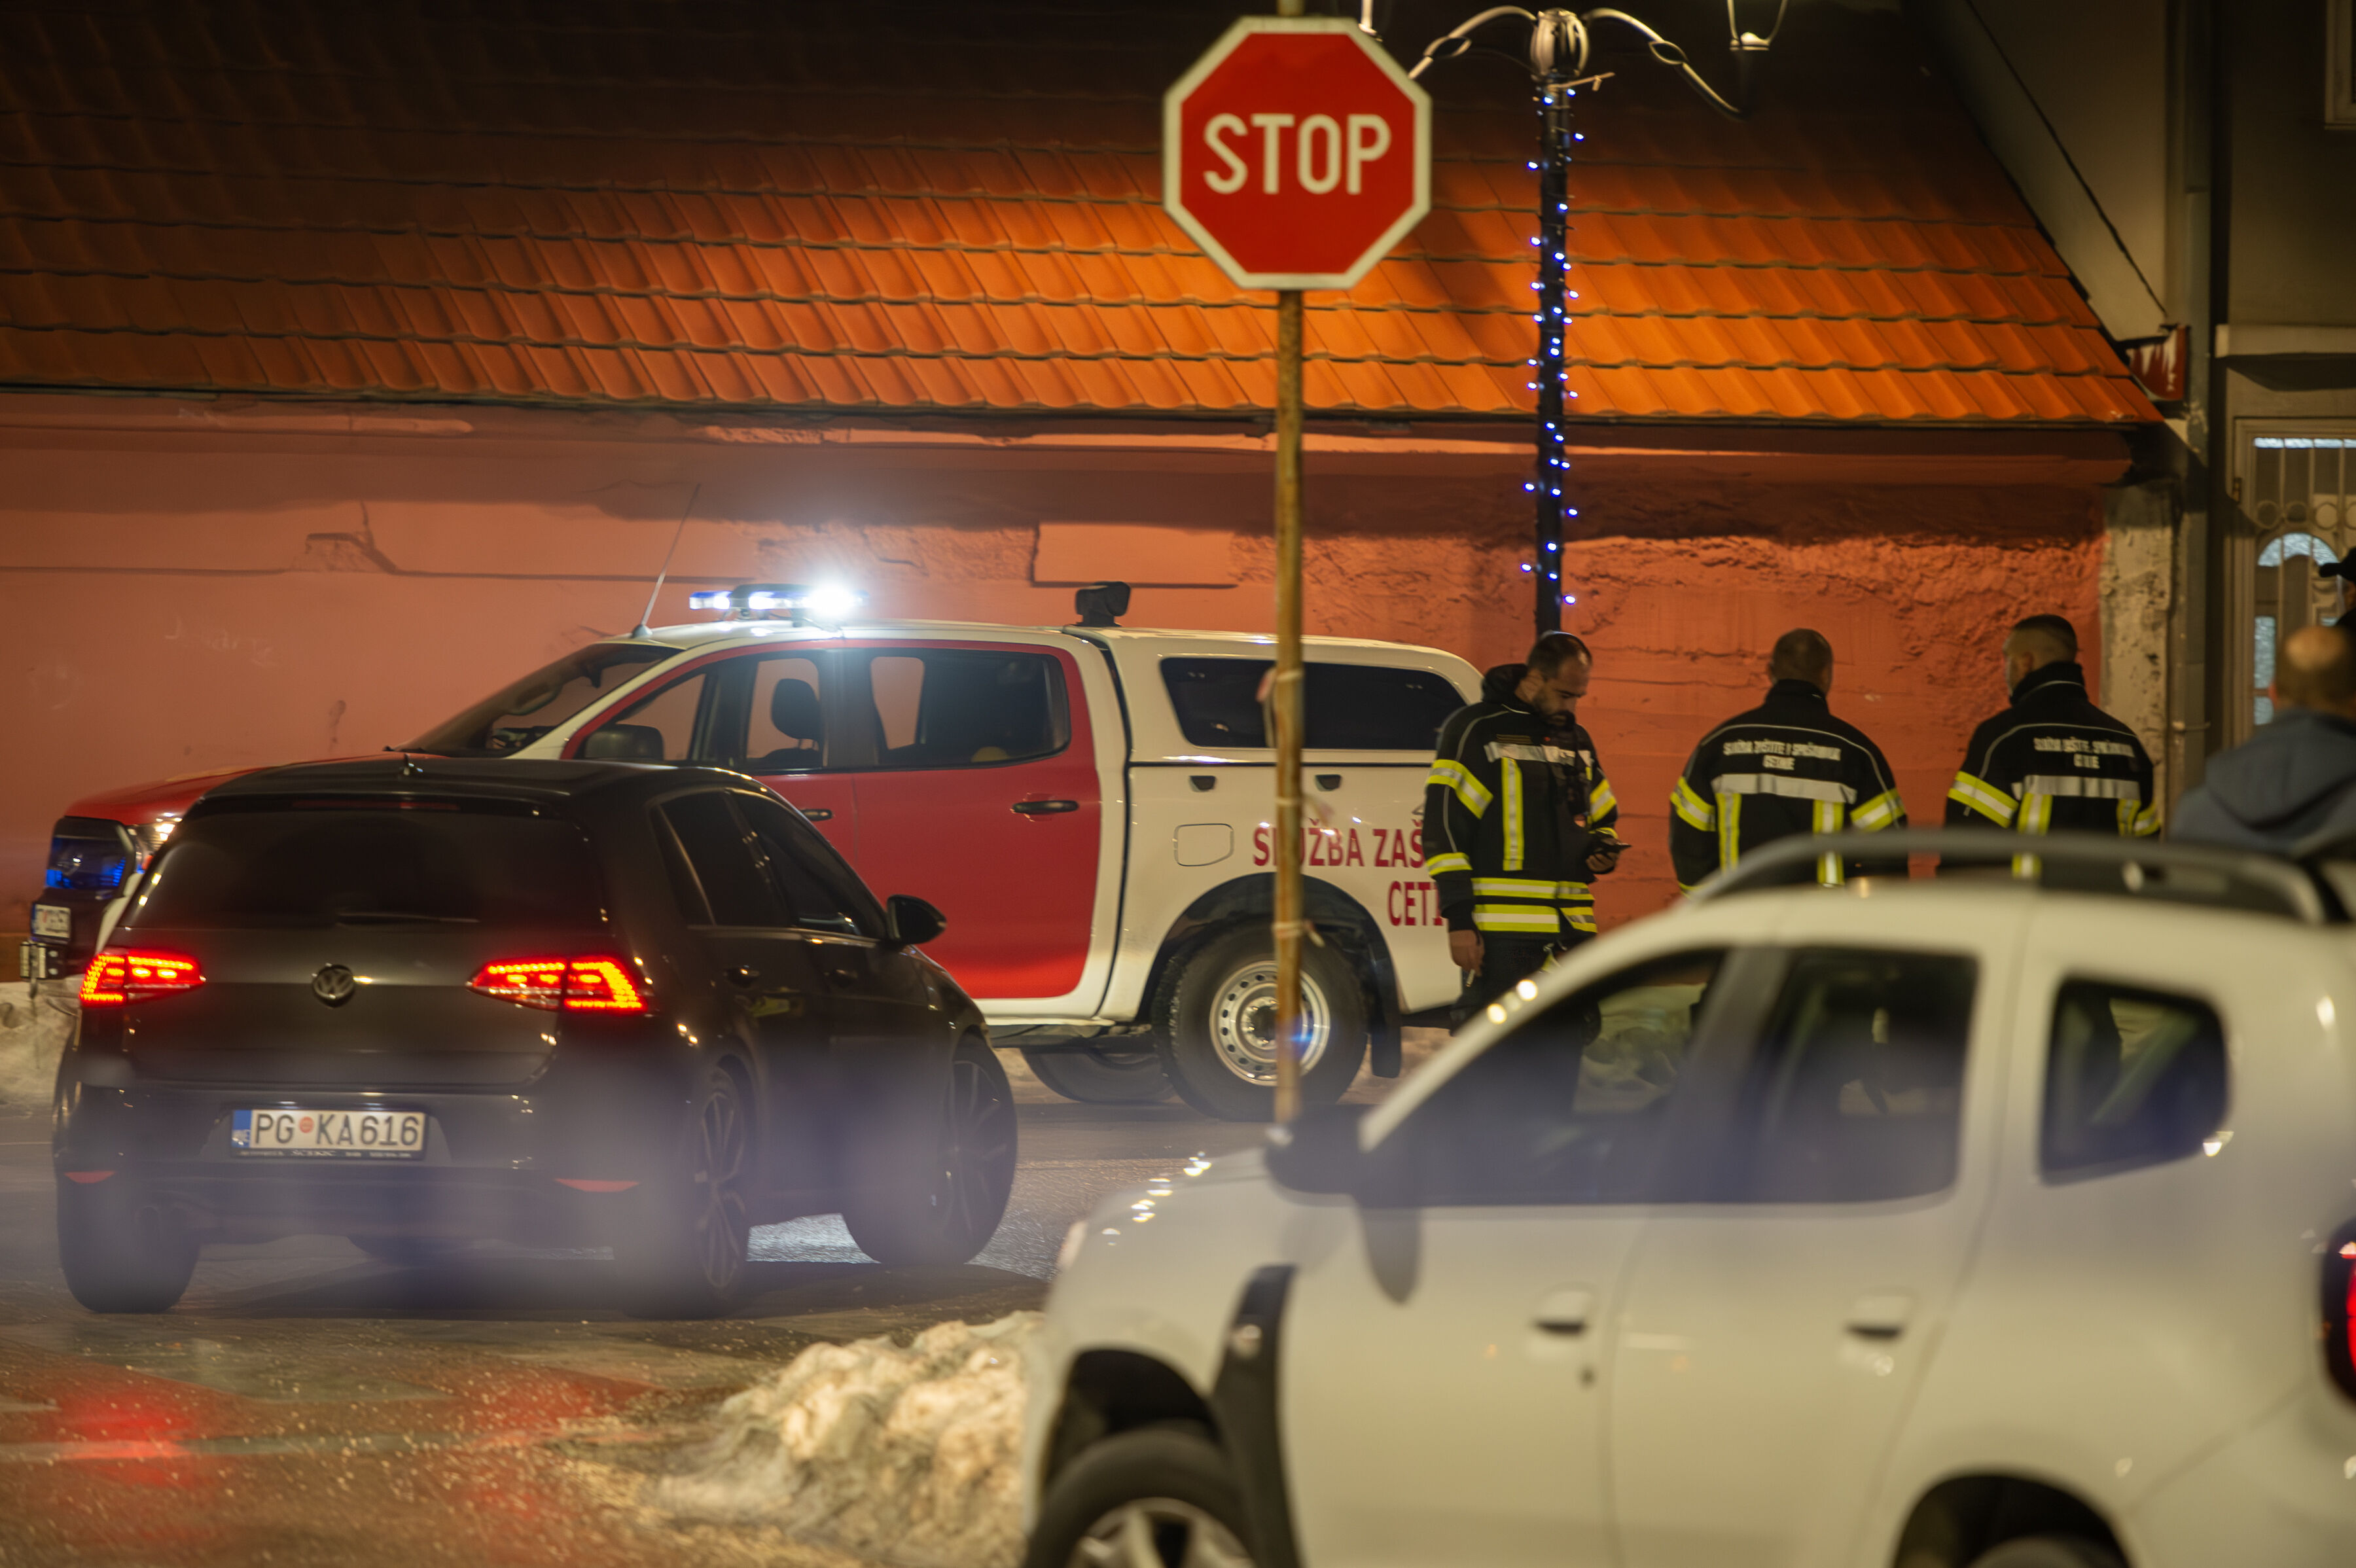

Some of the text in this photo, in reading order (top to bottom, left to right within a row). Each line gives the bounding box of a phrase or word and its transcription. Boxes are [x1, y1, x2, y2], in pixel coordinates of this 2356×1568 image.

[1204, 113, 1391, 195] STOP
[256, 1114, 420, 1146] PG KA616
